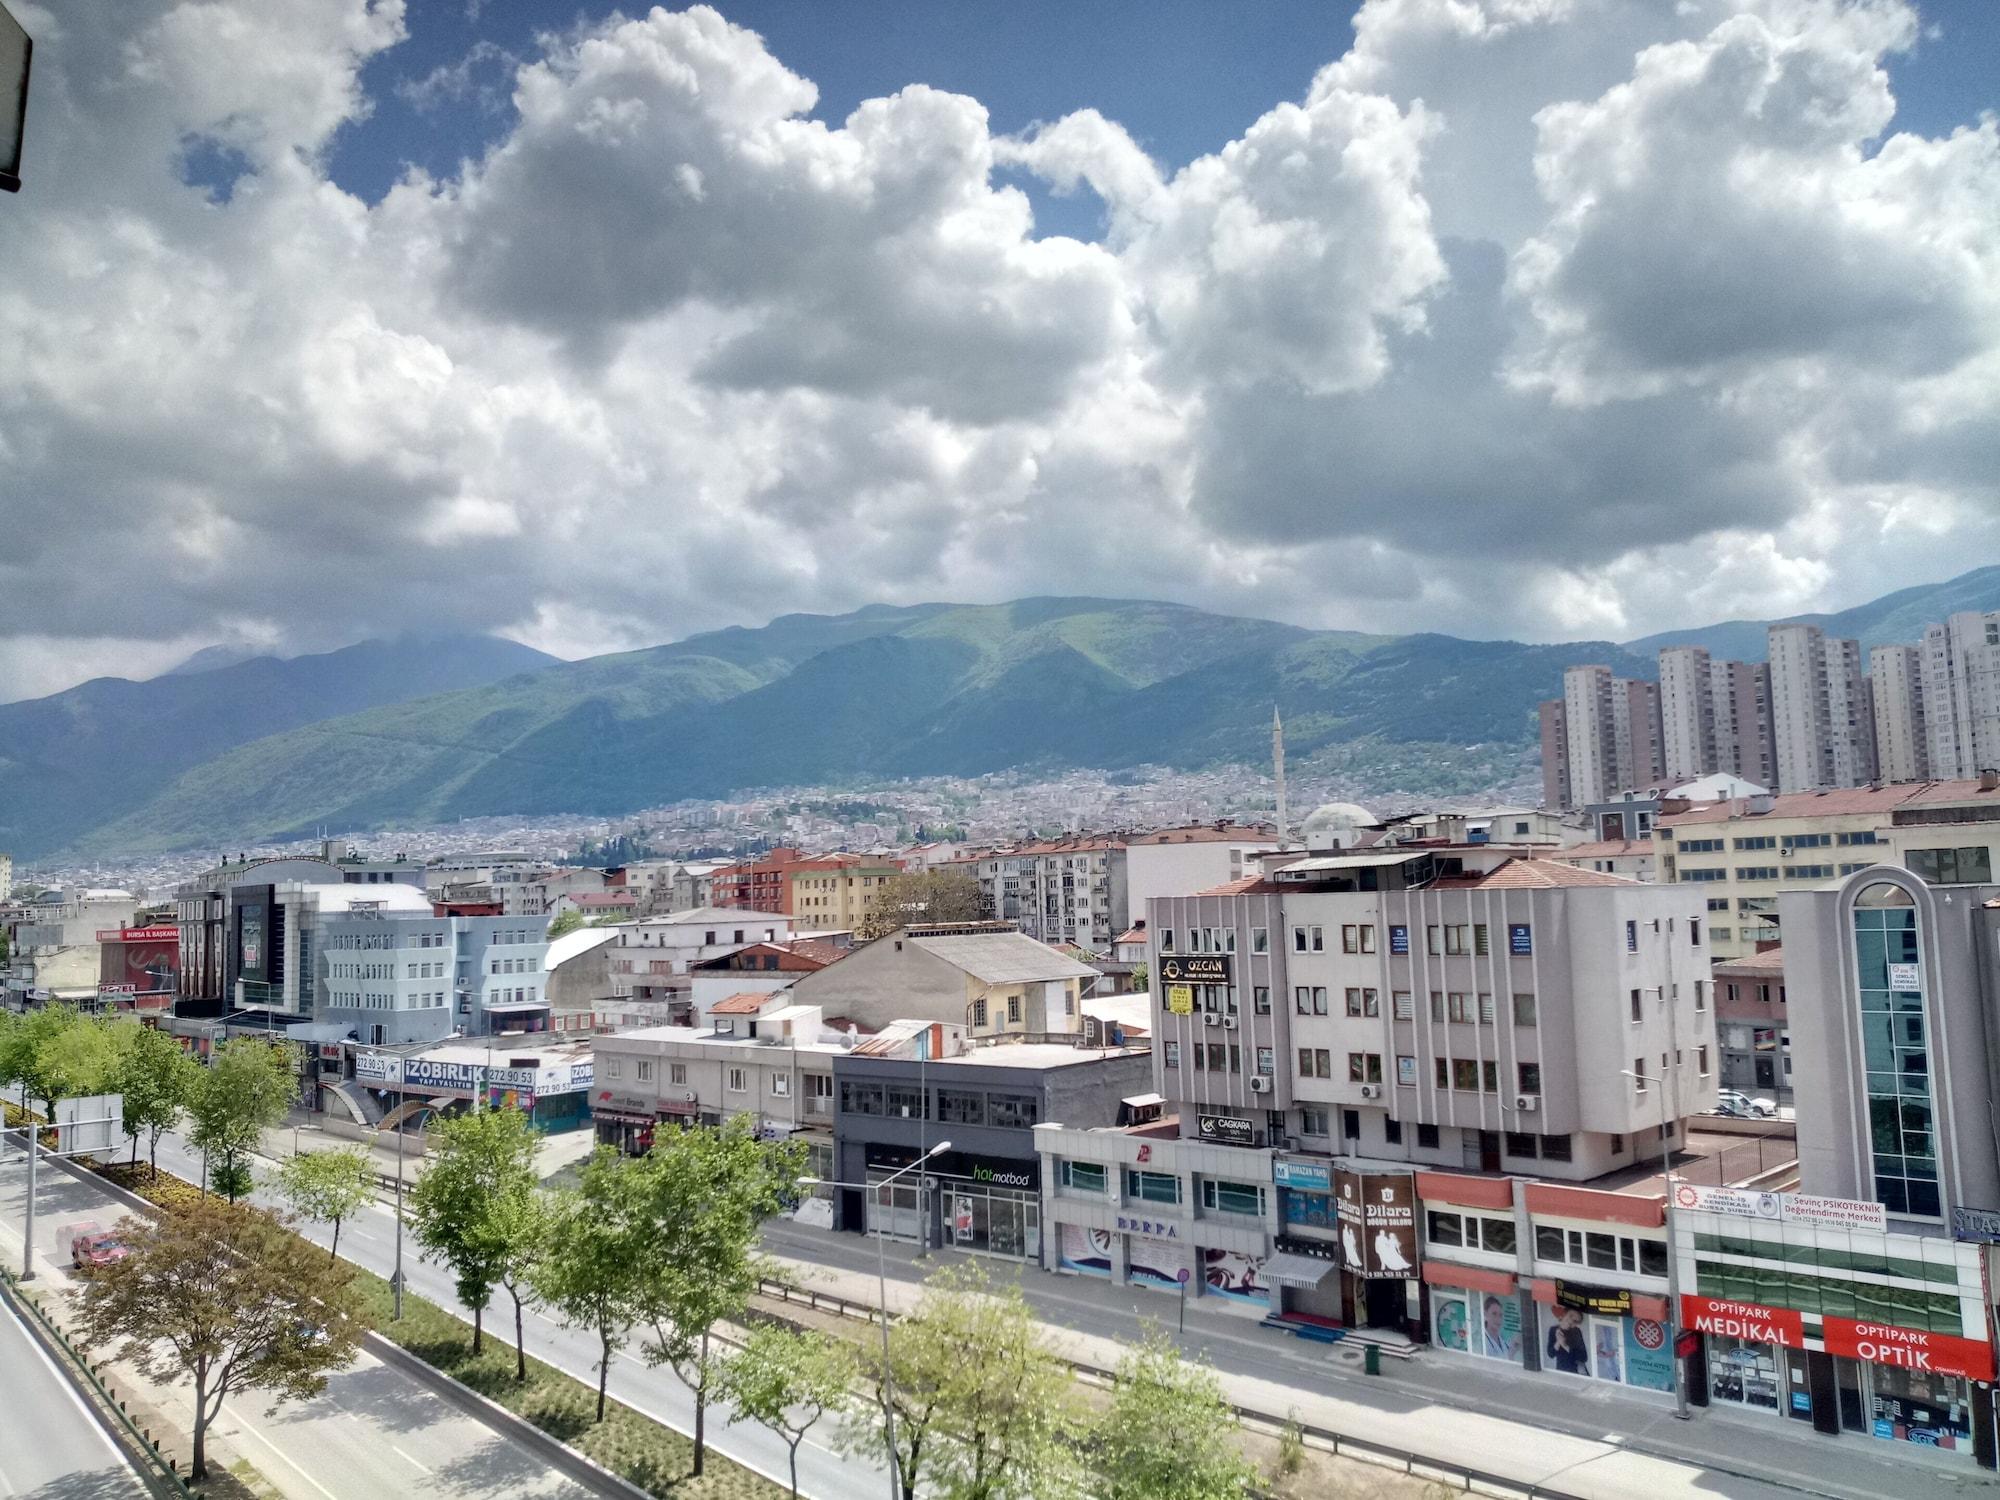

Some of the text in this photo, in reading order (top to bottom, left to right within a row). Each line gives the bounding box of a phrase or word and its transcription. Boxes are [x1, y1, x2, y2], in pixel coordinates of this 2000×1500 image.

[357, 1057, 367, 1068] 272
[489, 1070, 532, 1083] 272 90 53
[536, 1085, 549, 1094] 272
[551, 1084, 560, 1093] 90
[562, 1082, 571, 1092] 53
[1336, 1197, 1360, 1216] Dilara
[1366, 1204, 1411, 1217] Dilara
[1698, 1204, 1725, 1212] BURSA
[1704, 1199, 1750, 1208] SENDİKASI
[1794, 1197, 1880, 1213] Sevinç PSİKOTEKNİK
[1389, 1218, 1412, 1226] SALONU
[1785, 1205, 1881, 1223] Değerlendirme Merkezi
[1117, 1217, 1177, 1237] BERPA
[1708, 1301, 1771, 1320] OPTİPARK
[1695, 1315, 1790, 1345] MEDİKAL
[1855, 1324, 1929, 1346] OPTİPARK
[1856, 1342, 1931, 1370] OPTİK
